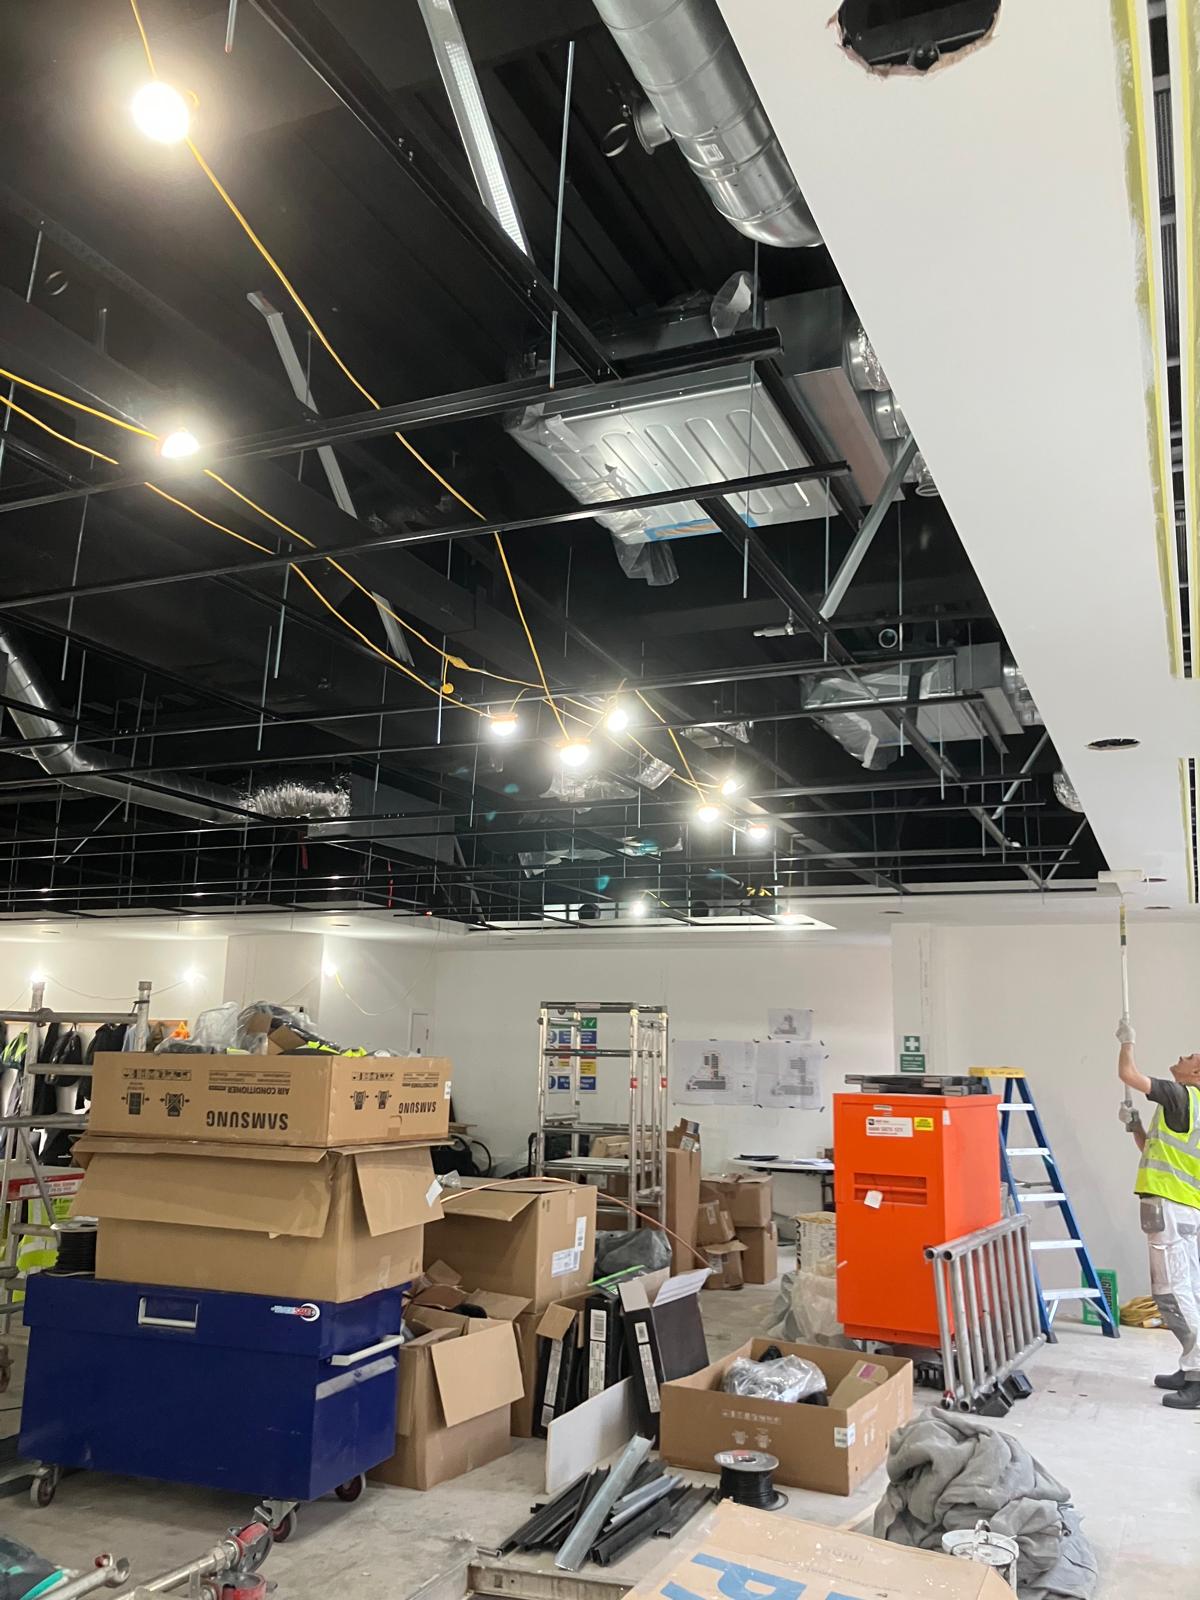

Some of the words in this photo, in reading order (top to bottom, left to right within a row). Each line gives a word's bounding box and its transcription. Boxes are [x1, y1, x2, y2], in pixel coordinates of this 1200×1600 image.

[227, 1086, 275, 1095] CONDITIONER
[275, 1087, 290, 1095] AIR
[398, 1101, 437, 1114] SAMSUNG
[206, 1110, 289, 1131] SAMSUNG
